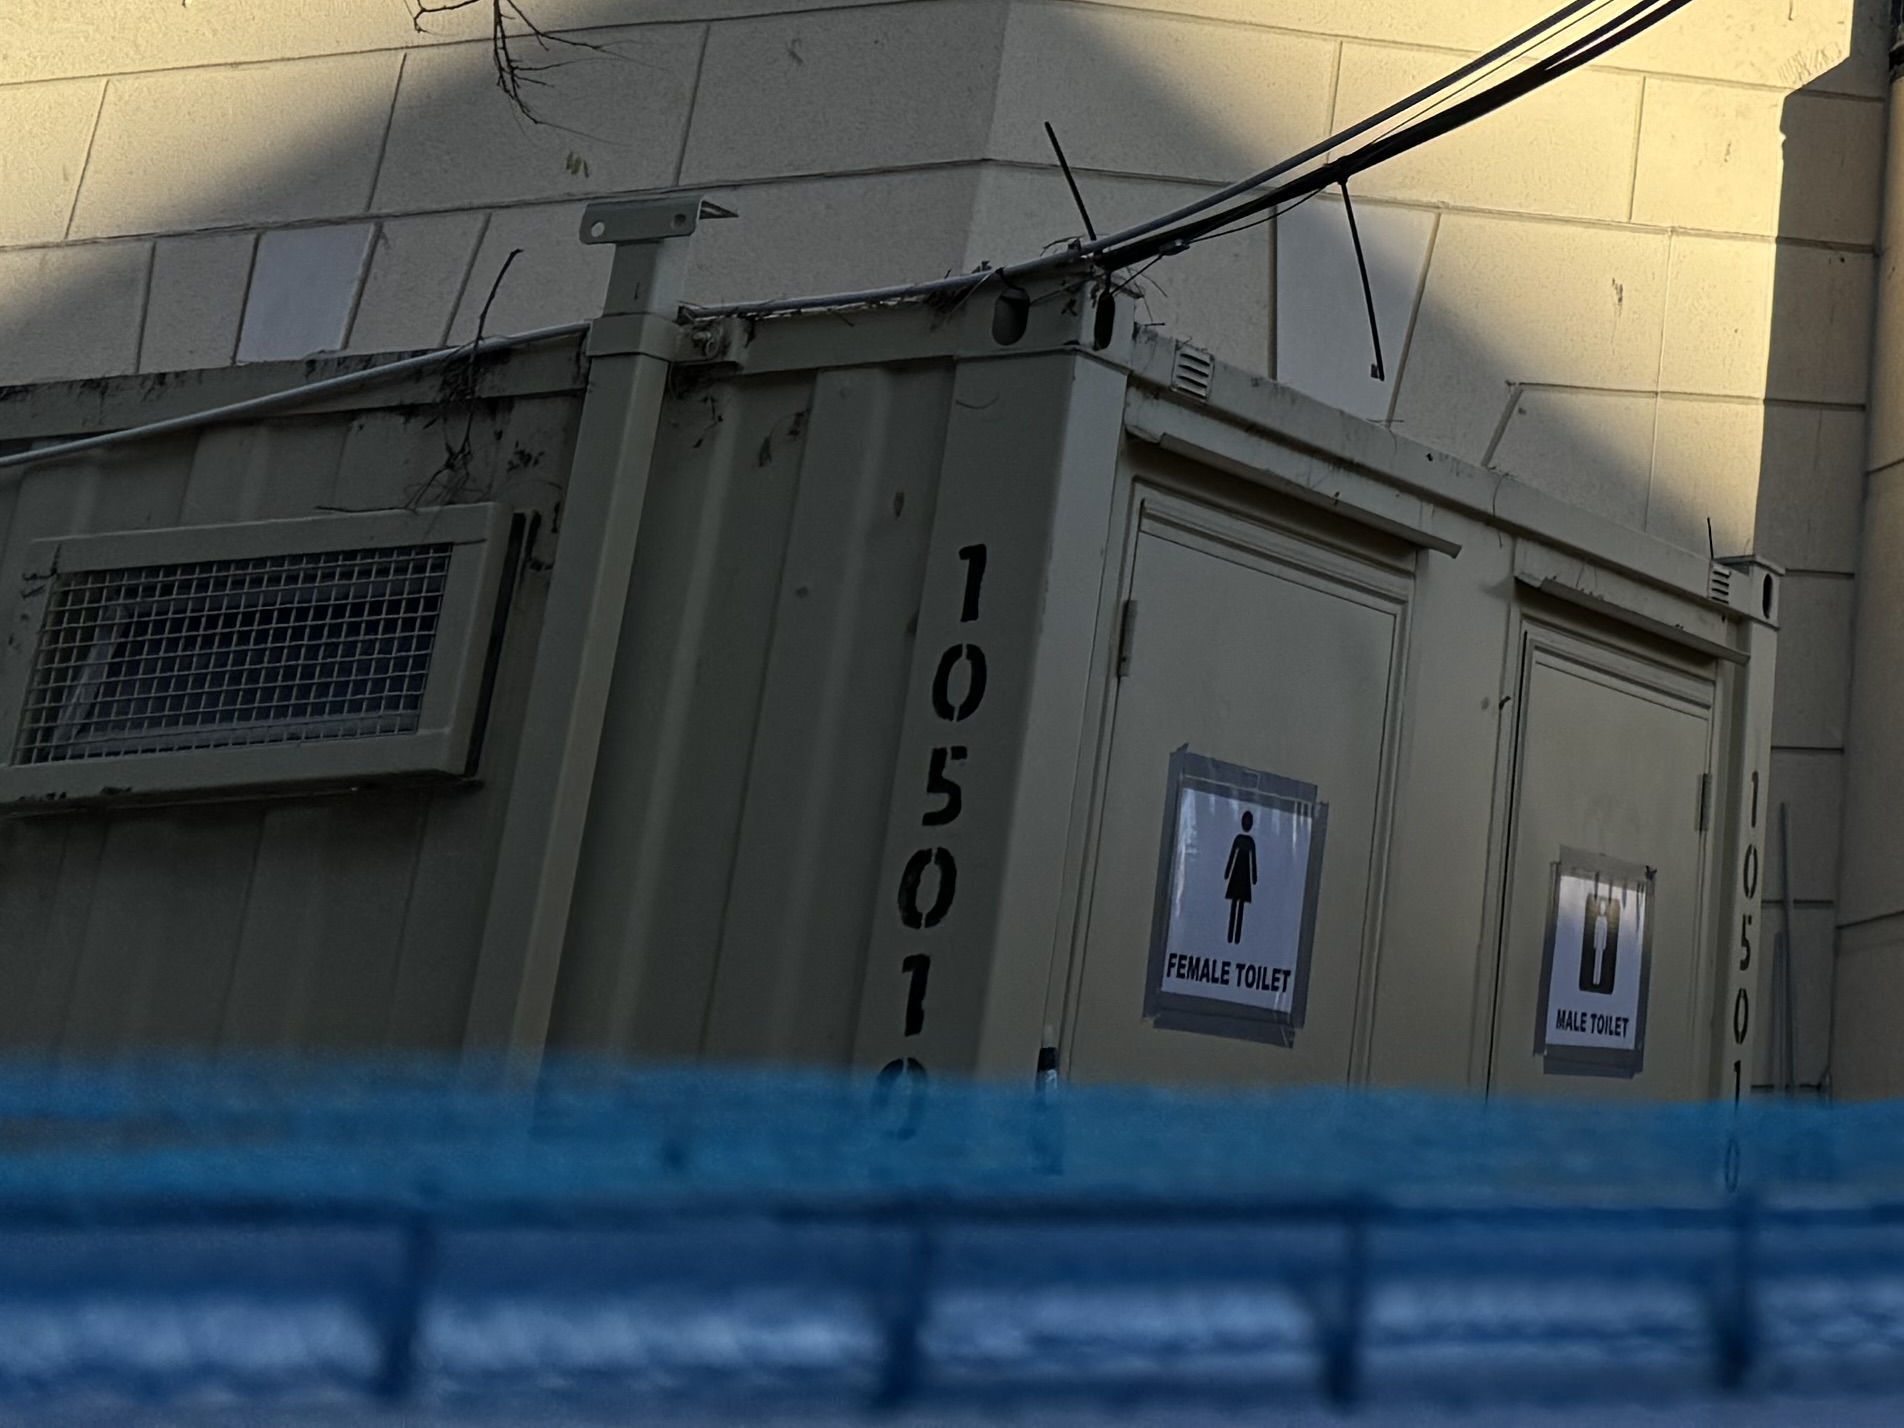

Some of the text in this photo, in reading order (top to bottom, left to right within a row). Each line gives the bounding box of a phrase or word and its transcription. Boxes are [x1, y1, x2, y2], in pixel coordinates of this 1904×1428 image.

[1166, 952, 1292, 993] FEMALE TOILET
[1555, 1008, 1630, 1039] MALE TOILET
